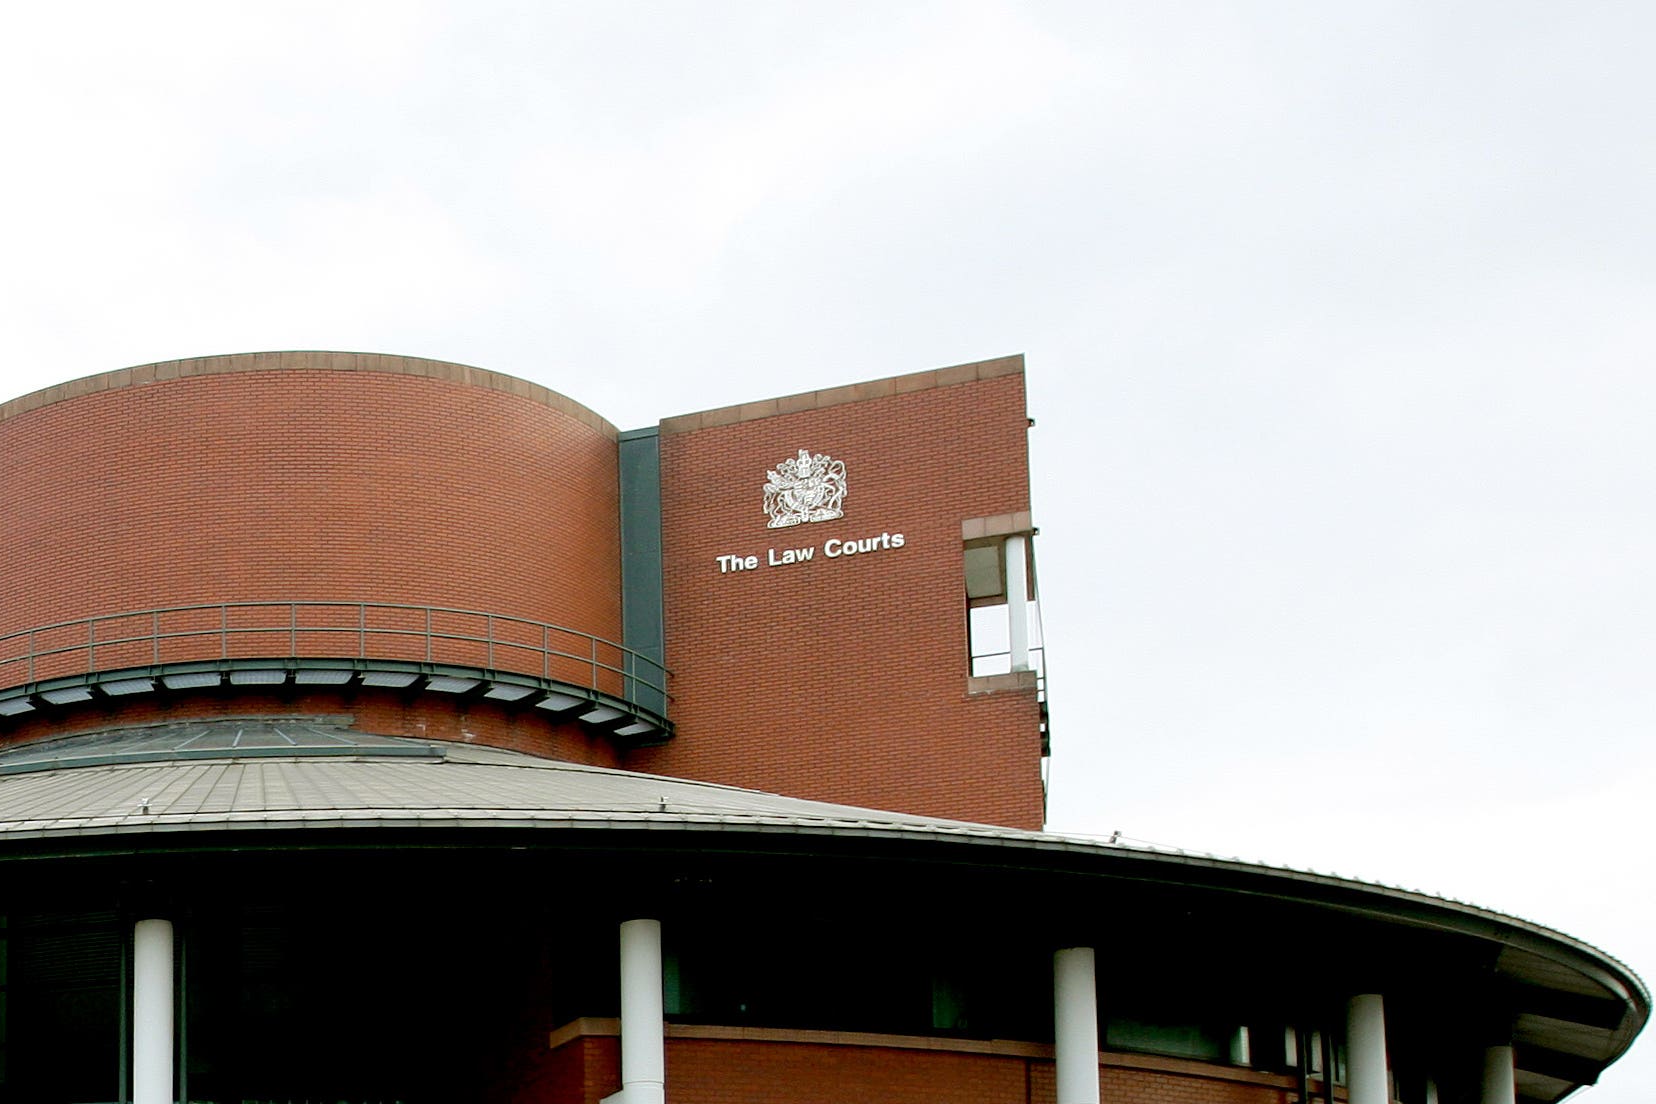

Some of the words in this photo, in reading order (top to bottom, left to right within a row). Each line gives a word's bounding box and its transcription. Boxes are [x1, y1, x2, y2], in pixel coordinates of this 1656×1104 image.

[716, 554, 758, 573] The
[768, 545, 815, 566] Law
[824, 532, 905, 558] Courts
